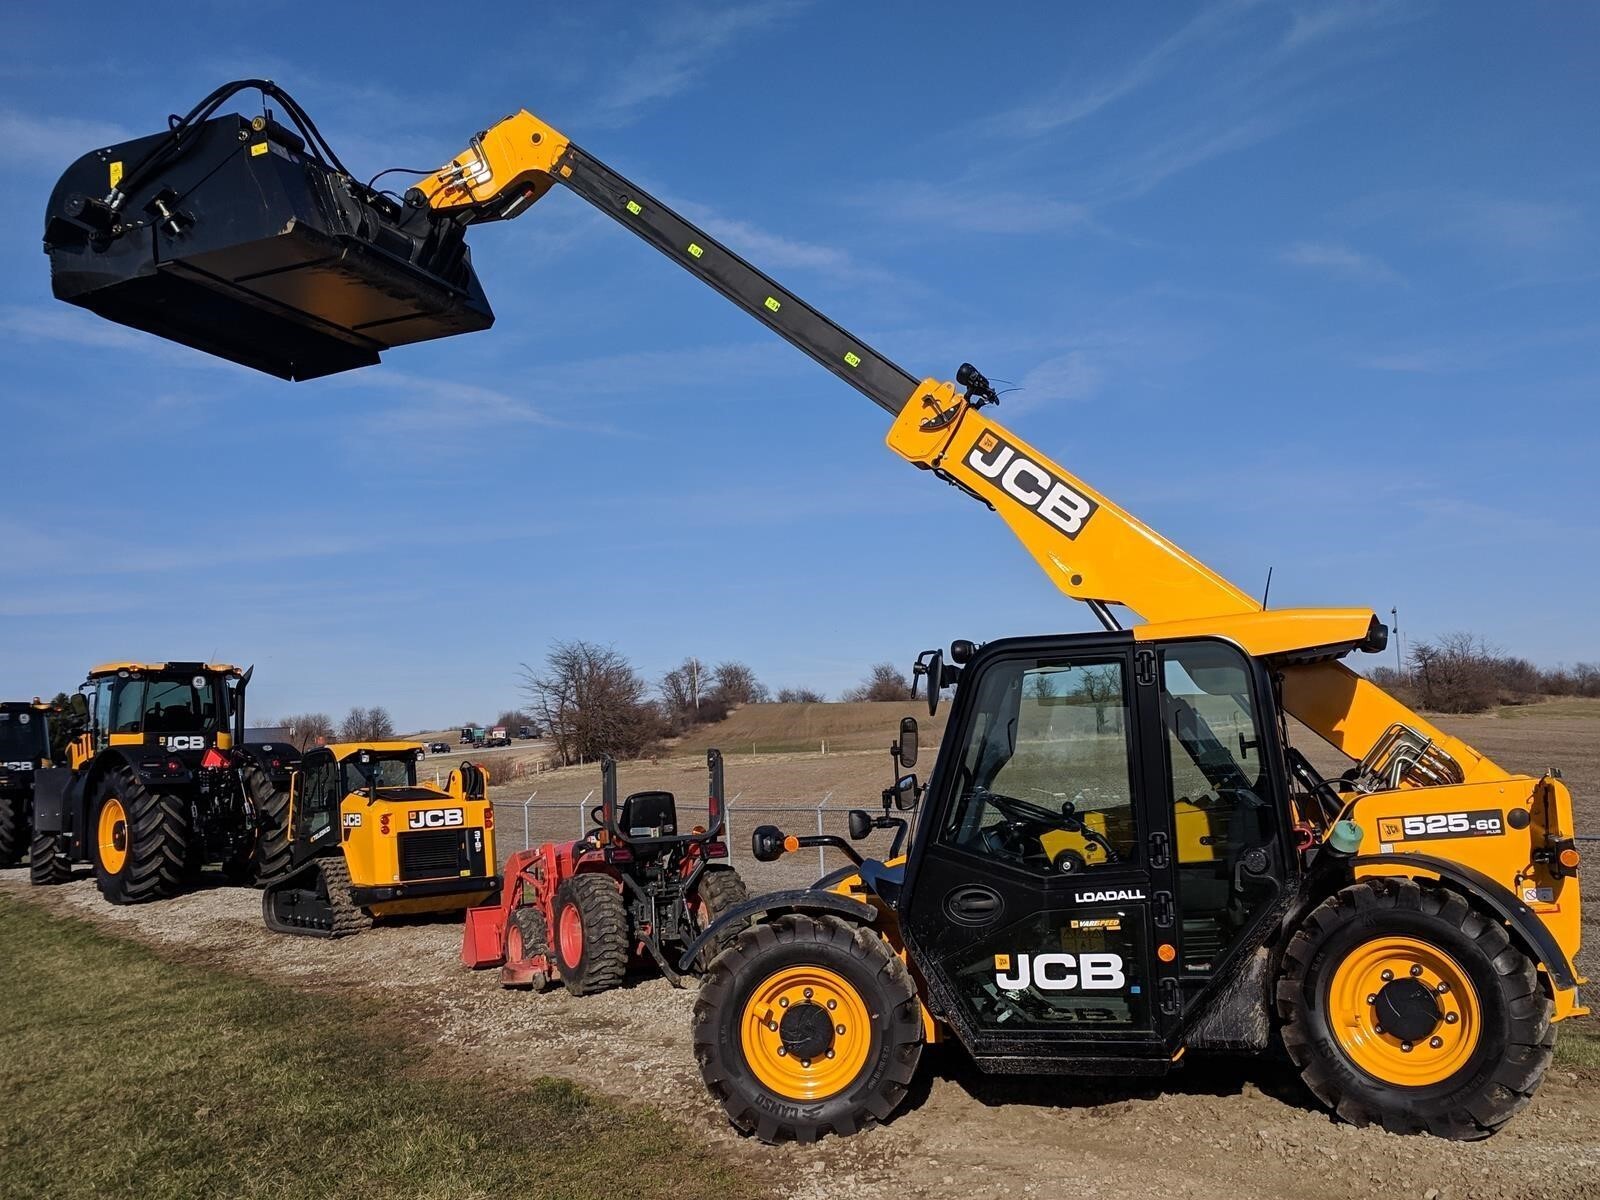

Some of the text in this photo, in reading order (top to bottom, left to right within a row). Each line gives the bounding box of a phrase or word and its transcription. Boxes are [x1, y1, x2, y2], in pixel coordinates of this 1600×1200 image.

[969, 446, 1090, 533] JCB
[159, 736, 205, 751] JCB
[343, 813, 362, 826] JCB
[410, 809, 463, 828] JCB
[1075, 889, 1146, 903] LOADALL
[996, 953, 1126, 990] JCB
[754, 1093, 799, 1120] CAMSO
